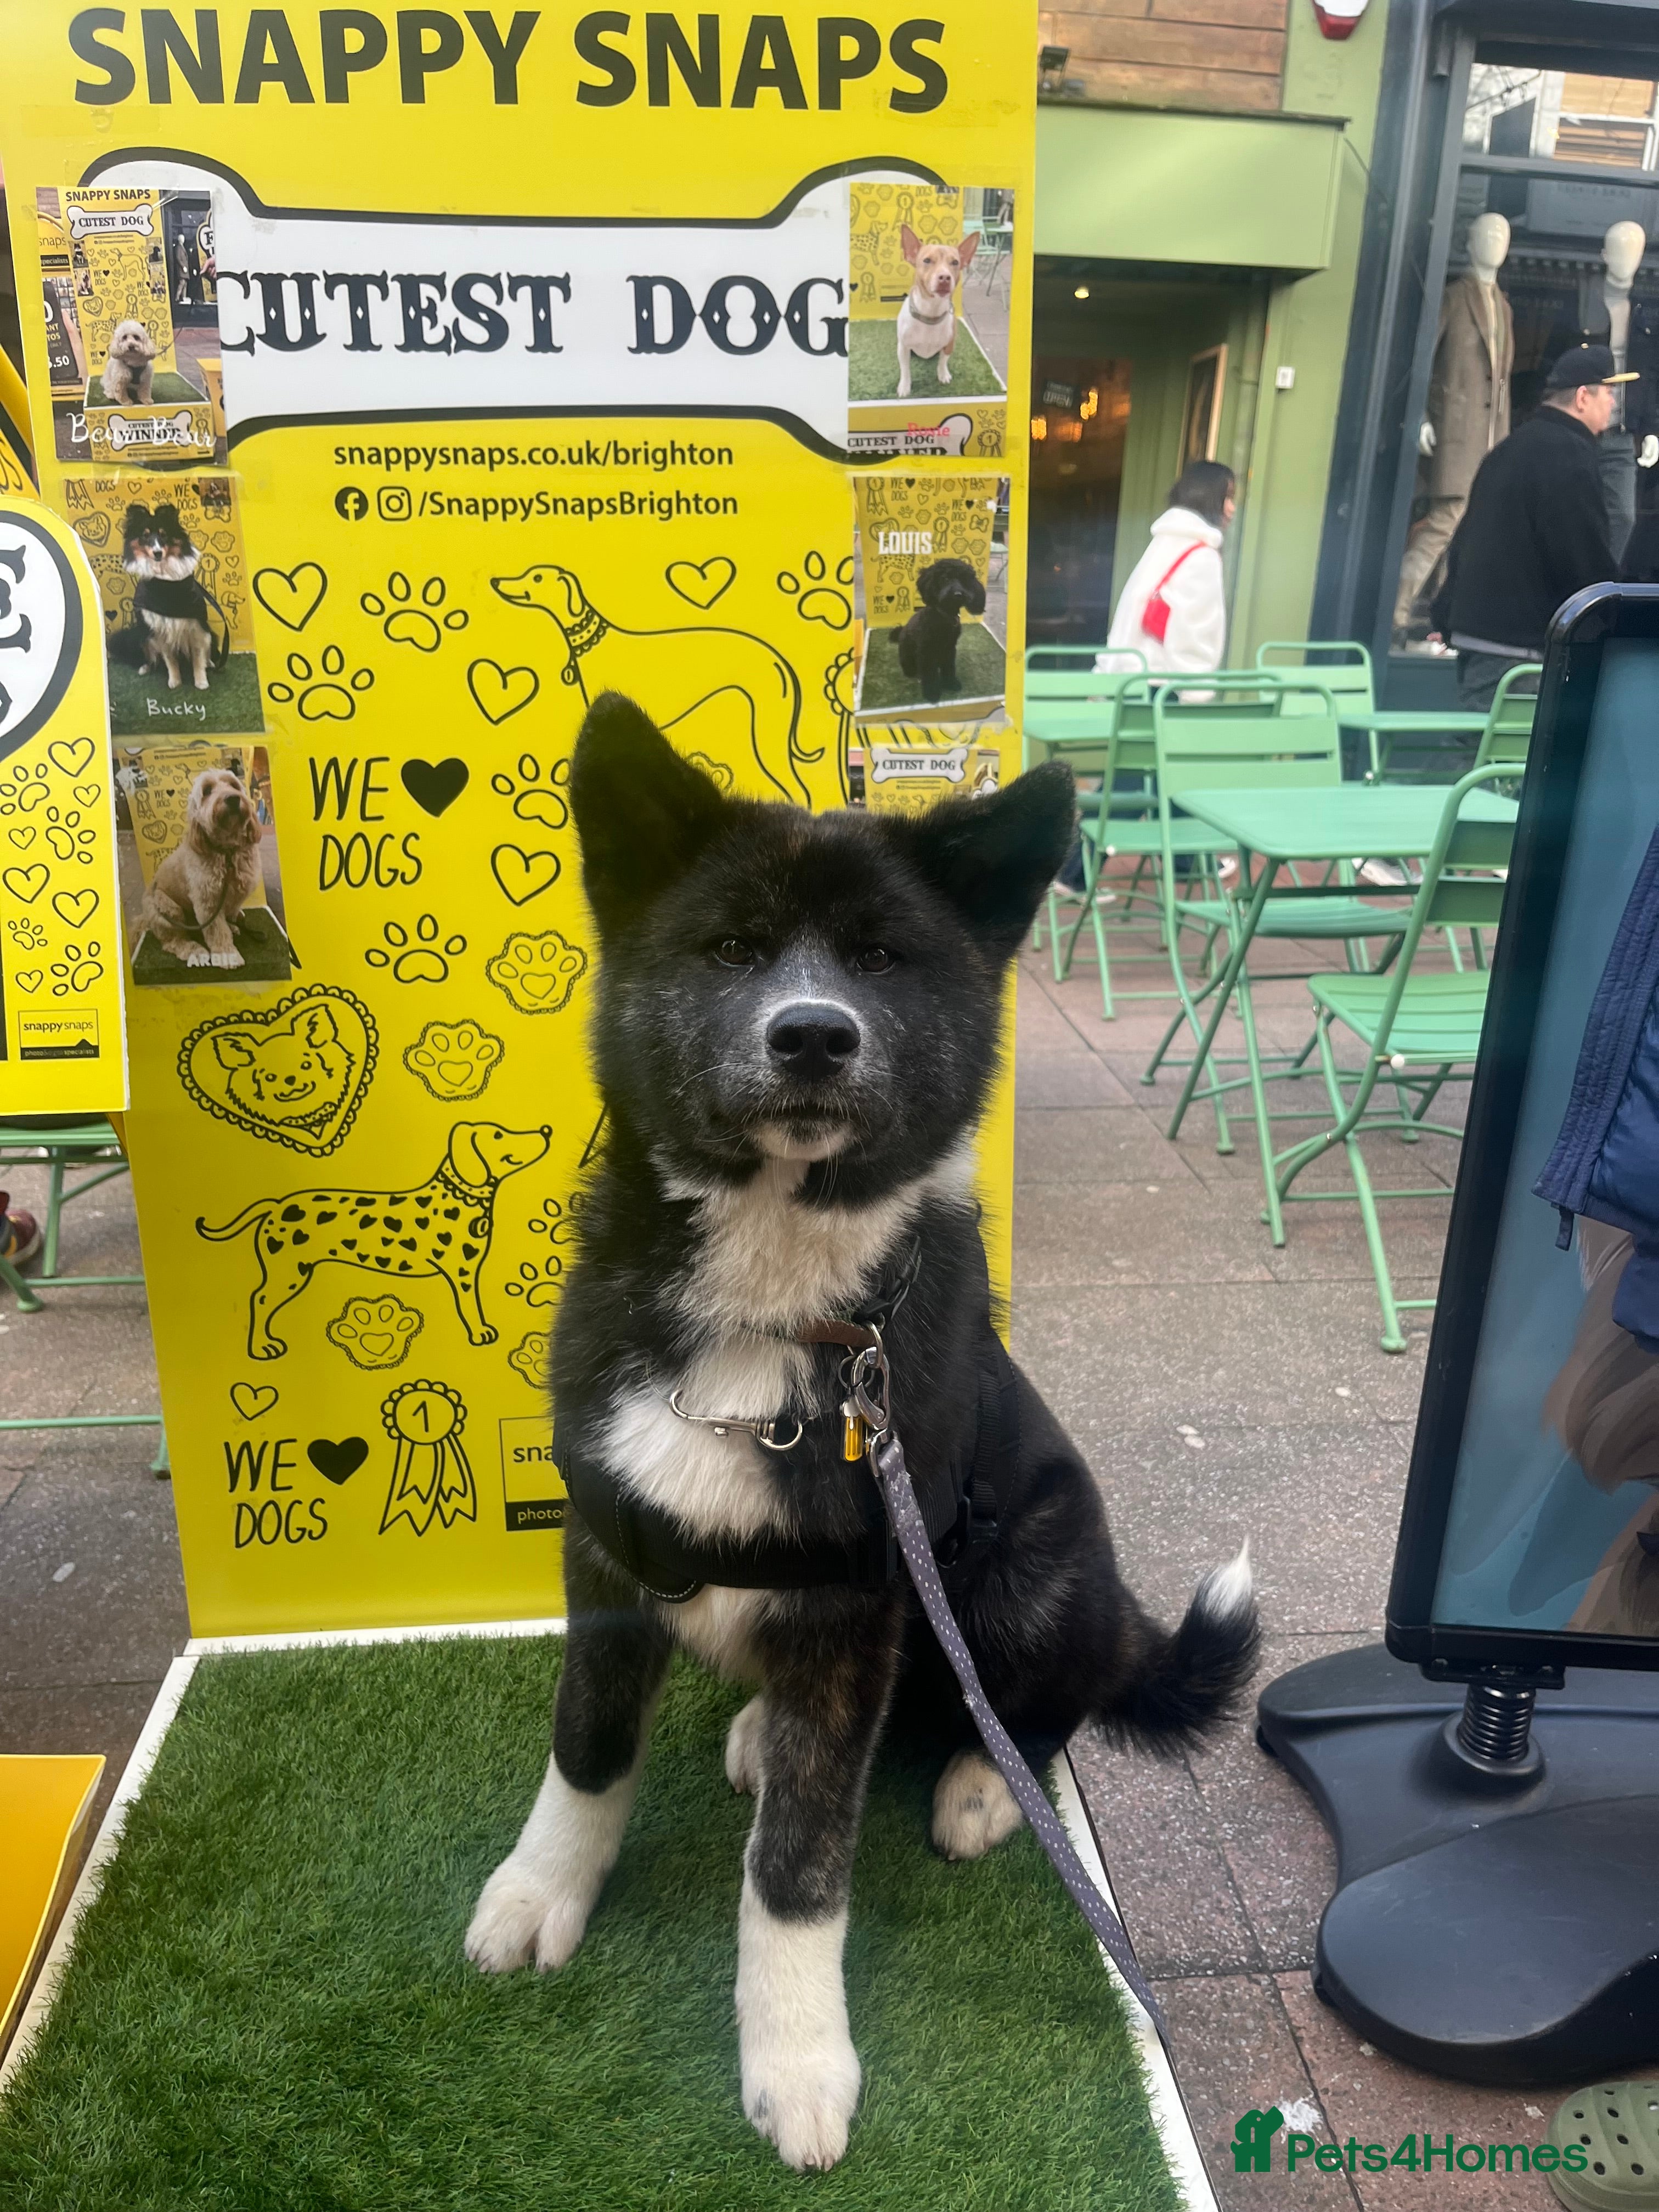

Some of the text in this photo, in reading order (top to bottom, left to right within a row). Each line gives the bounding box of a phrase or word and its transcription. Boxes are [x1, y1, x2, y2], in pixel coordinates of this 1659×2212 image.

[68, 8, 949, 114] SNAPPY SNAPS
[65, 189, 150, 201] SNAPPY SNAPS
[79, 216, 144, 227] CUTEST DOG
[41, 257, 69, 266] pecialists
[216, 270, 848, 357] CUTEST DOG
[848, 435, 935, 448] CUTEST DOG
[334, 440, 733, 472] snappysnaps.co.uk/brighton
[95, 480, 116, 493] DOGS
[174, 483, 190, 498] WE
[177, 498, 198, 511] DOGS
[419, 490, 738, 522] /SnappySnapsBrighton
[878, 531, 933, 555] LOUIS
[146, 697, 206, 721] Bucky
[882, 759, 956, 770] CUTEST DOG
[309, 757, 390, 822] WE
[319, 832, 423, 891] DOGS
[24, 1021, 94, 1032] snappy snaps
[223, 1438, 297, 1493] WE
[234, 1498, 328, 1548] DOGS
